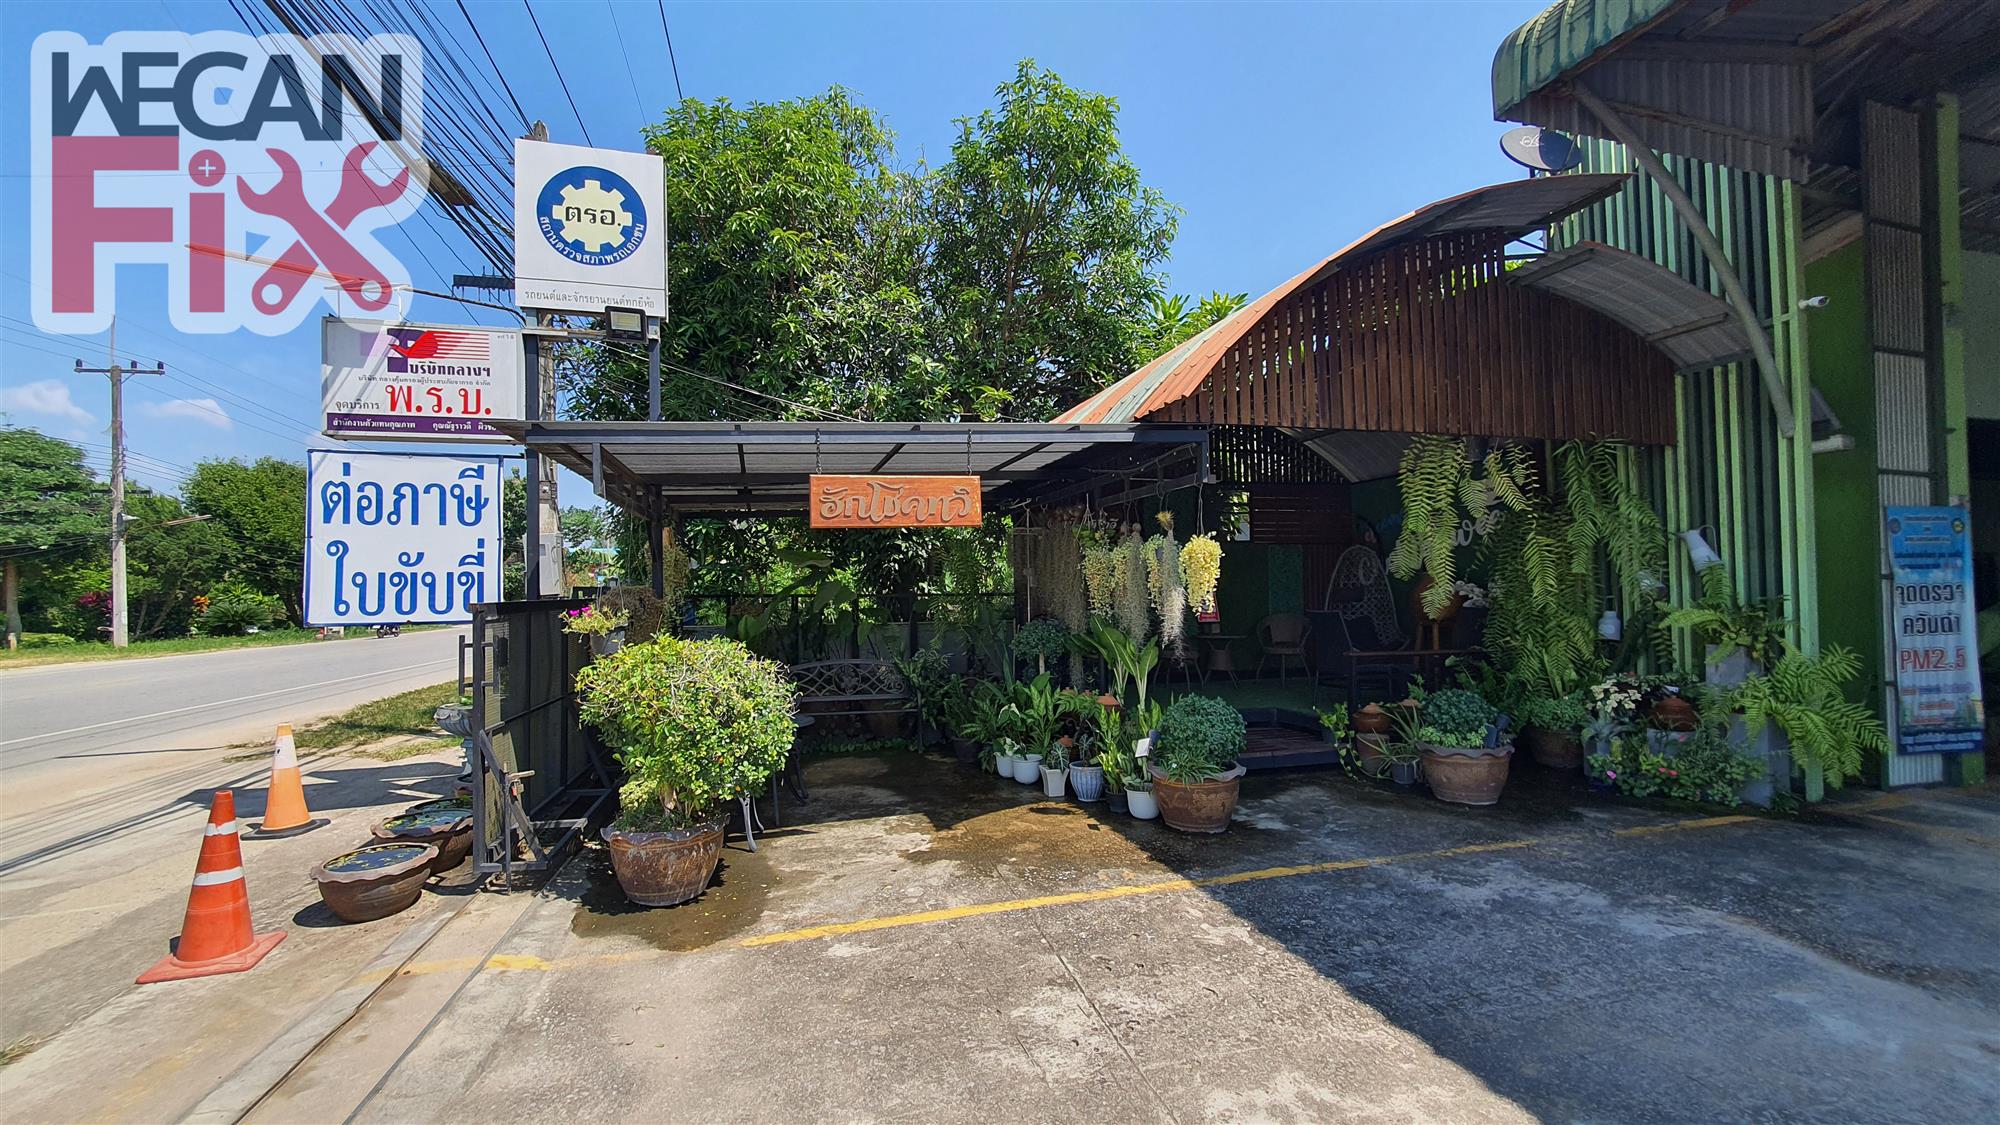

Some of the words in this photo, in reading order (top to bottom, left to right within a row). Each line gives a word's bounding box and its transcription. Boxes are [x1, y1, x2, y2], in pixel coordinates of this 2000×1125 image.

[565, 206, 621, 226] ตรอ.
[540, 216, 645, 265] สถานตรวจสภาพรถเอกชน
[409, 360, 491, 377] บริษัทกลางฯ
[335, 398, 380, 412] จุดบริการ
[385, 384, 491, 415] พ.ร.บ.
[320, 462, 490, 527] ต่อภาษี
[326, 538, 486, 617] ใบขับขี่
[1900, 647, 1969, 671] PM2.5
